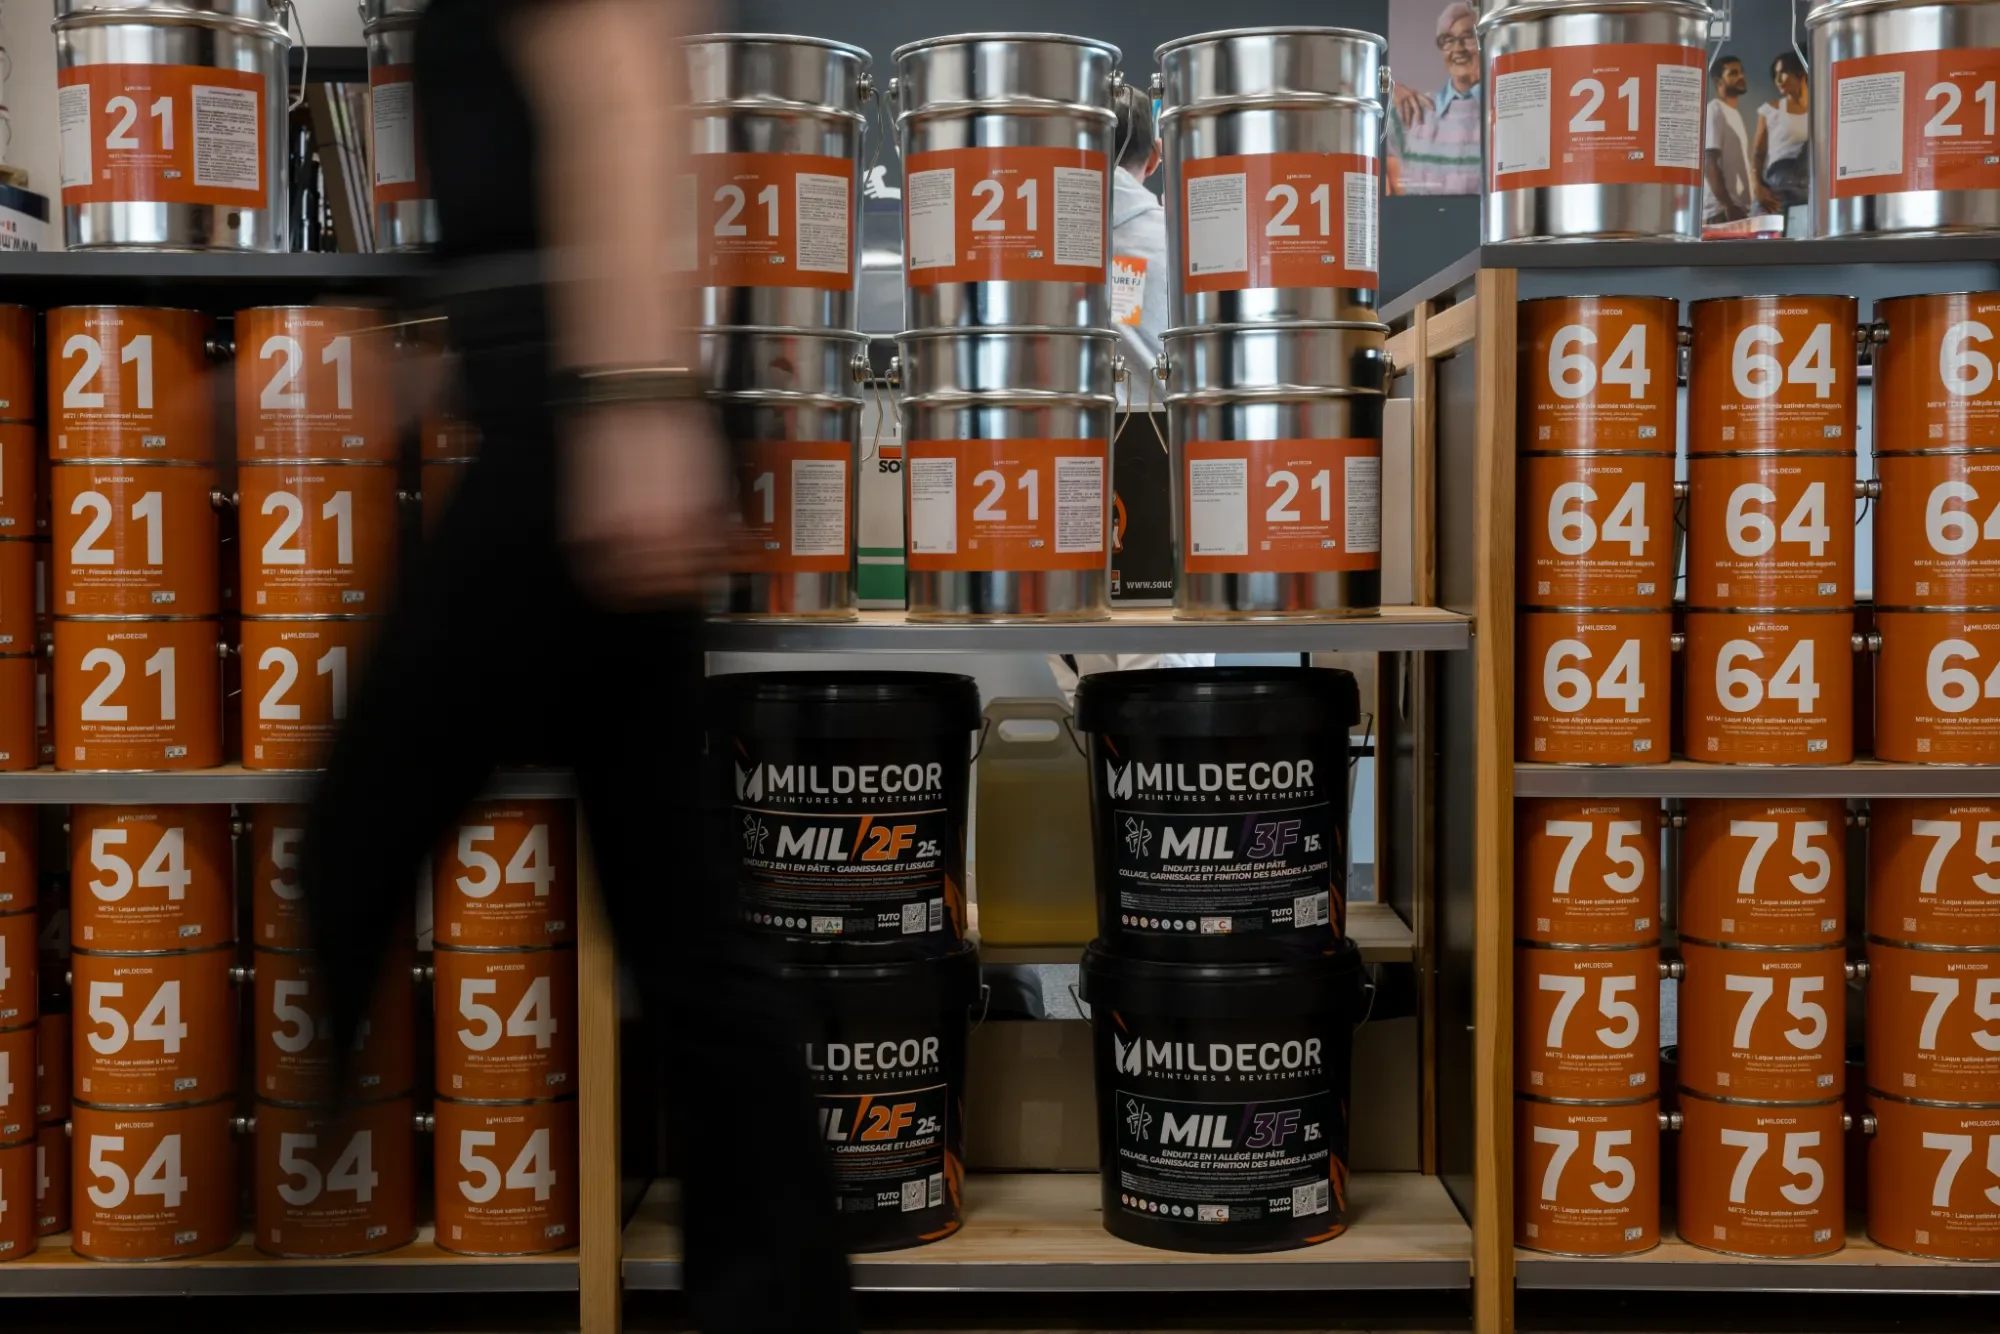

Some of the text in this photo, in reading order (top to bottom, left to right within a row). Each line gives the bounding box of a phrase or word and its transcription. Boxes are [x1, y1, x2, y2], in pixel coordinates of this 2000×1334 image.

[105, 95, 174, 150] 21
[1568, 76, 1640, 133] 21
[1923, 80, 1996, 137] 21
[713, 184, 779, 236] 21
[971, 178, 1038, 231] 21
[1265, 183, 1330, 236] 21
[62, 334, 153, 409] 21
[259, 335, 353, 410] 21
[1548, 324, 1651, 399] 64
[1732, 323, 1836, 399] 64
[1939, 320, 2000, 397] 6
[879, 460, 902, 473] SO
[973, 469, 1039, 521] 21
[1265, 469, 1330, 522] 21
[1548, 481, 1650, 557] 64
[1725, 482, 1831, 557] 64
[70, 490, 163, 565] 21
[261, 490, 353, 565] 21
[80, 646, 176, 721] 21
[258, 646, 348, 720] 21
[1543, 638, 1645, 713] 64
[1715, 639, 1820, 714] 64
[768, 762, 943, 794] MILDECOR
[768, 795, 838, 804] PEINTURES
[862, 793, 943, 804] REVÊTEMENTS
[1136, 759, 1314, 792] MILDECOR
[1137, 793, 1206, 802] PEINTURES
[1230, 790, 1315, 801] REVÊTEMENTS
[89, 827, 192, 902] 54
[270, 827, 306, 900] 5
[455, 824, 555, 899] 54
[769, 861, 775, 869] 2
[775, 862, 788, 870] EN
[793, 863, 806, 871] EN
[807, 863, 830, 873] PÂTE
[837, 864, 893, 873] GARNISSAGE
[894, 863, 905, 871] ET
[905, 860, 935, 870] LISSAGE
[775, 825, 849, 861] MIL
[861, 825, 917, 861] 2F
[1160, 826, 1234, 860] MIL
[1246, 819, 1302, 860] 3F
[1162, 864, 1193, 873] ENDUIT
[1194, 864, 1200, 872] 3
[1200, 864, 1214, 872] EN
[1253, 862, 1265, 870] EN
[1265, 860, 1287, 870] PÂTE
[1545, 820, 1645, 894] 75
[1730, 820, 1831, 895] 75
[1119, 868, 1149, 880] COLLAGE,
[1150, 872, 1201, 881] GARNISSAGE
[1202, 873, 1214, 881] ET
[1214, 872, 1252, 881] FINITION
[1253, 871, 1269, 879] DES
[1270, 868, 1301, 878] BANDES
[1308, 861, 1328, 873] JOINTS
[825, 918, 840, 929] A+
[877, 912, 900, 922] TUTO
[1218, 920, 1226, 929] C
[1271, 908, 1293, 918] TUTO
[87, 980, 188, 1055] 54
[457, 976, 558, 1051] 54
[1538, 973, 1640, 1049] 75
[1725, 974, 1828, 1050] 75
[1910, 975, 2000, 1051] 75
[805, 1036, 940, 1072] LDECOR
[857, 1066, 940, 1081] REVÊTEMENTS
[1146, 1037, 1322, 1072] MILDECOR
[1147, 1070, 1217, 1082] PEINTURES
[1240, 1067, 1322, 1082] REVÊTEMENTS
[836, 1136, 935, 1153] GARNISSAGE ET LISSAGE
[861, 1102, 917, 1141] 2F
[1160, 1111, 1233, 1149] MIL
[1245, 1108, 1302, 1149] 3F
[87, 1134, 188, 1209] 54
[277, 1130, 378, 1206] 54
[458, 1128, 557, 1204] 54
[1120, 1148, 1149, 1163] COLLAGE,
[1150, 1156, 1199, 1169] GARNISSAGE
[1200, 1160, 1212, 1169] ET
[1212, 1160, 1250, 1169] FINITION
[1251, 1160, 1268, 1168] DES
[1269, 1156, 1300, 1167] BANDES
[1307, 1149, 1328, 1161] JOINTS
[1162, 1149, 1192, 1159] ENDUIT
[1192, 1151, 1198, 1160] 3
[1199, 1152, 1213, 1160] EN
[1251, 1152, 1263, 1160] EN
[1264, 1148, 1285, 1159] PÂTE
[1533, 1126, 1636, 1204] 75
[1720, 1128, 1824, 1205] 75
[877, 1192, 900, 1201] TUTO
[1216, 1208, 1224, 1218] C
[1269, 1197, 1291, 1206] TUTO
